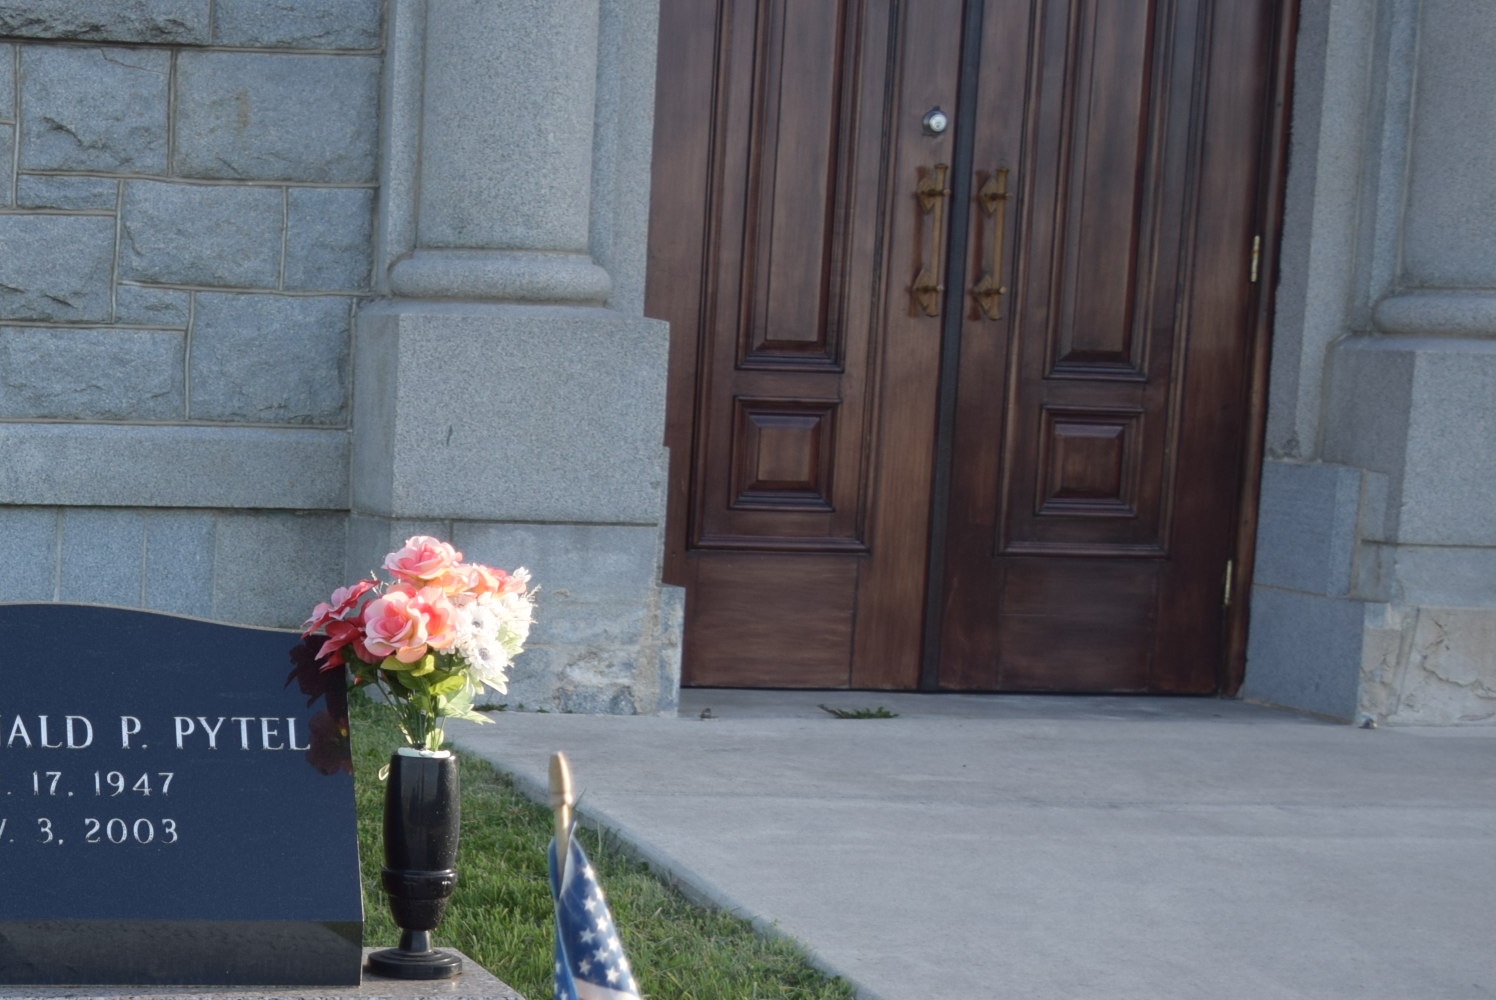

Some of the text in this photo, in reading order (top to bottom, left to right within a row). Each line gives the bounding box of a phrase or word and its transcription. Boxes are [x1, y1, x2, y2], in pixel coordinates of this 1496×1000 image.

[121, 716, 147, 749] P.
[174, 717, 310, 750] PYTEL
[33, 771, 73, 796] 17,
[95, 771, 173, 796] 1947
[38, 818, 63, 844] 3,
[85, 818, 177, 843] 2003
